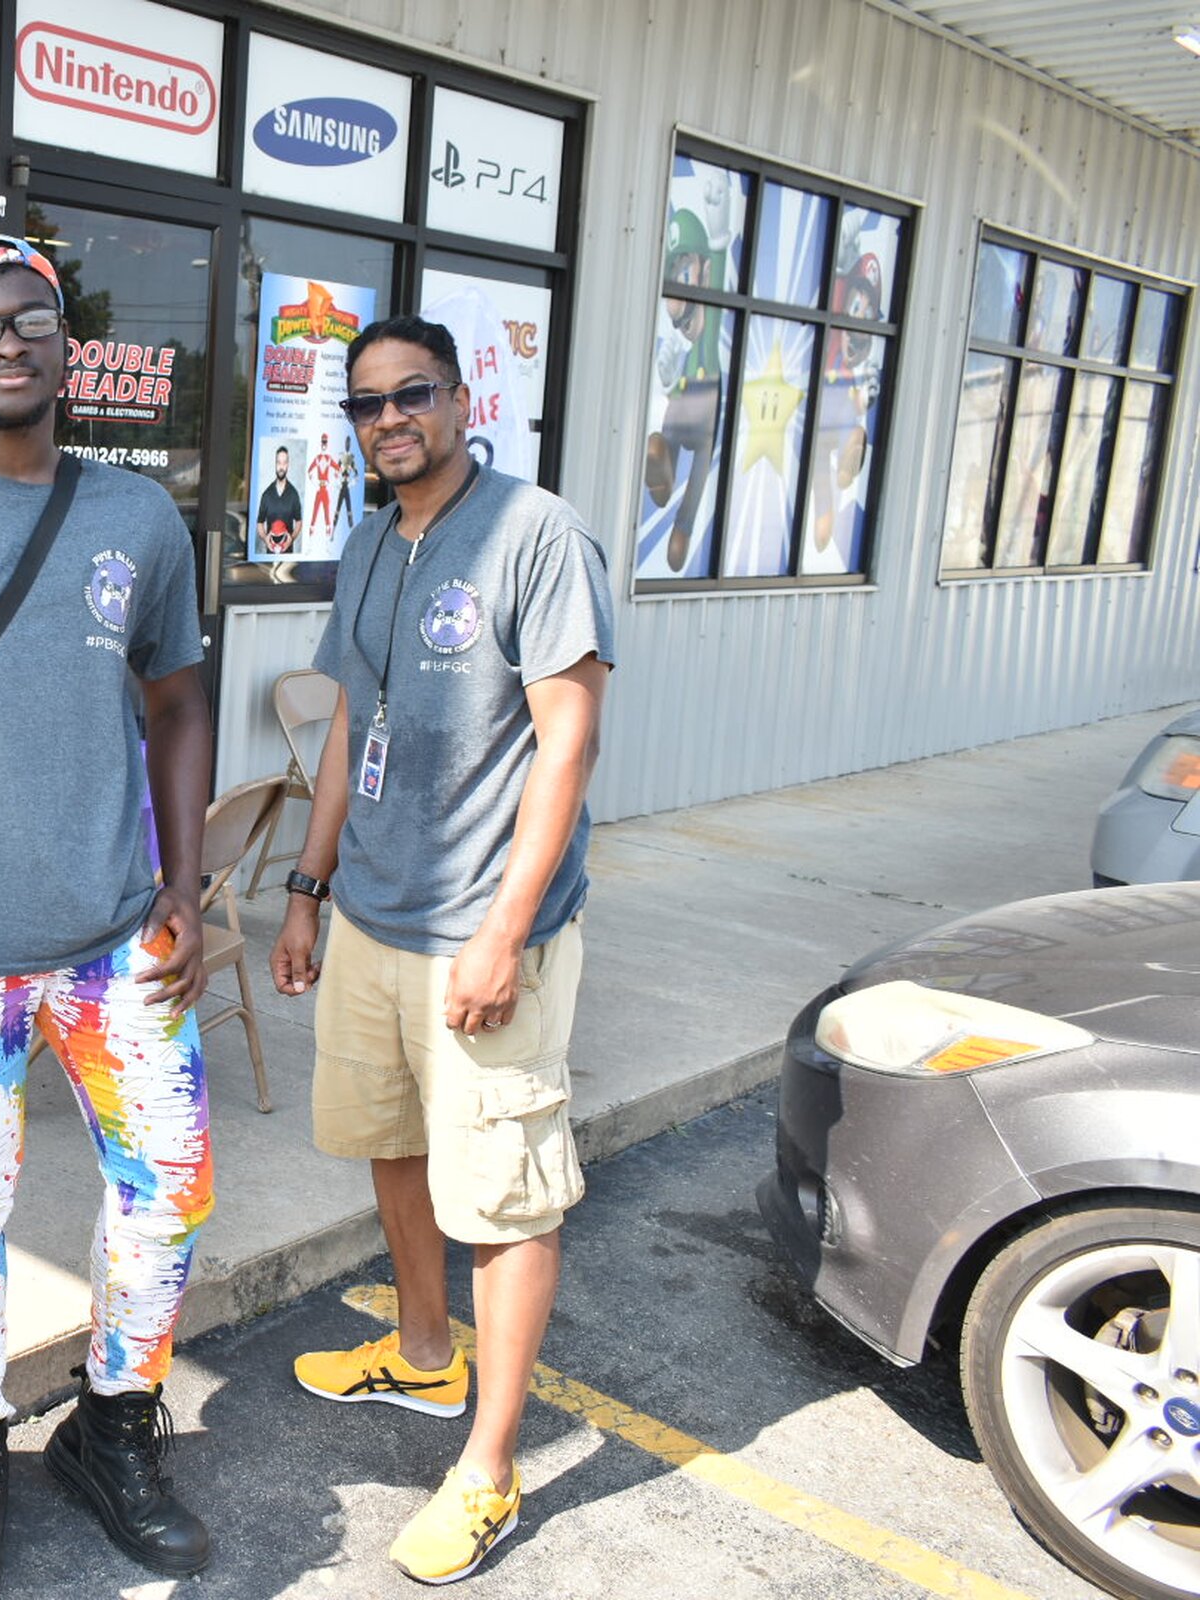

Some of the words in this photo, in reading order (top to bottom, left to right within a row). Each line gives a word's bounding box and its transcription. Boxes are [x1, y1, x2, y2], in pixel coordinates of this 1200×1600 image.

[273, 105, 381, 158] SAMSUNG
[476, 159, 548, 204] PS4
[67, 338, 176, 376] DOUBLE
[57, 369, 173, 406] HEADER
[72, 405, 98, 416] GAMES
